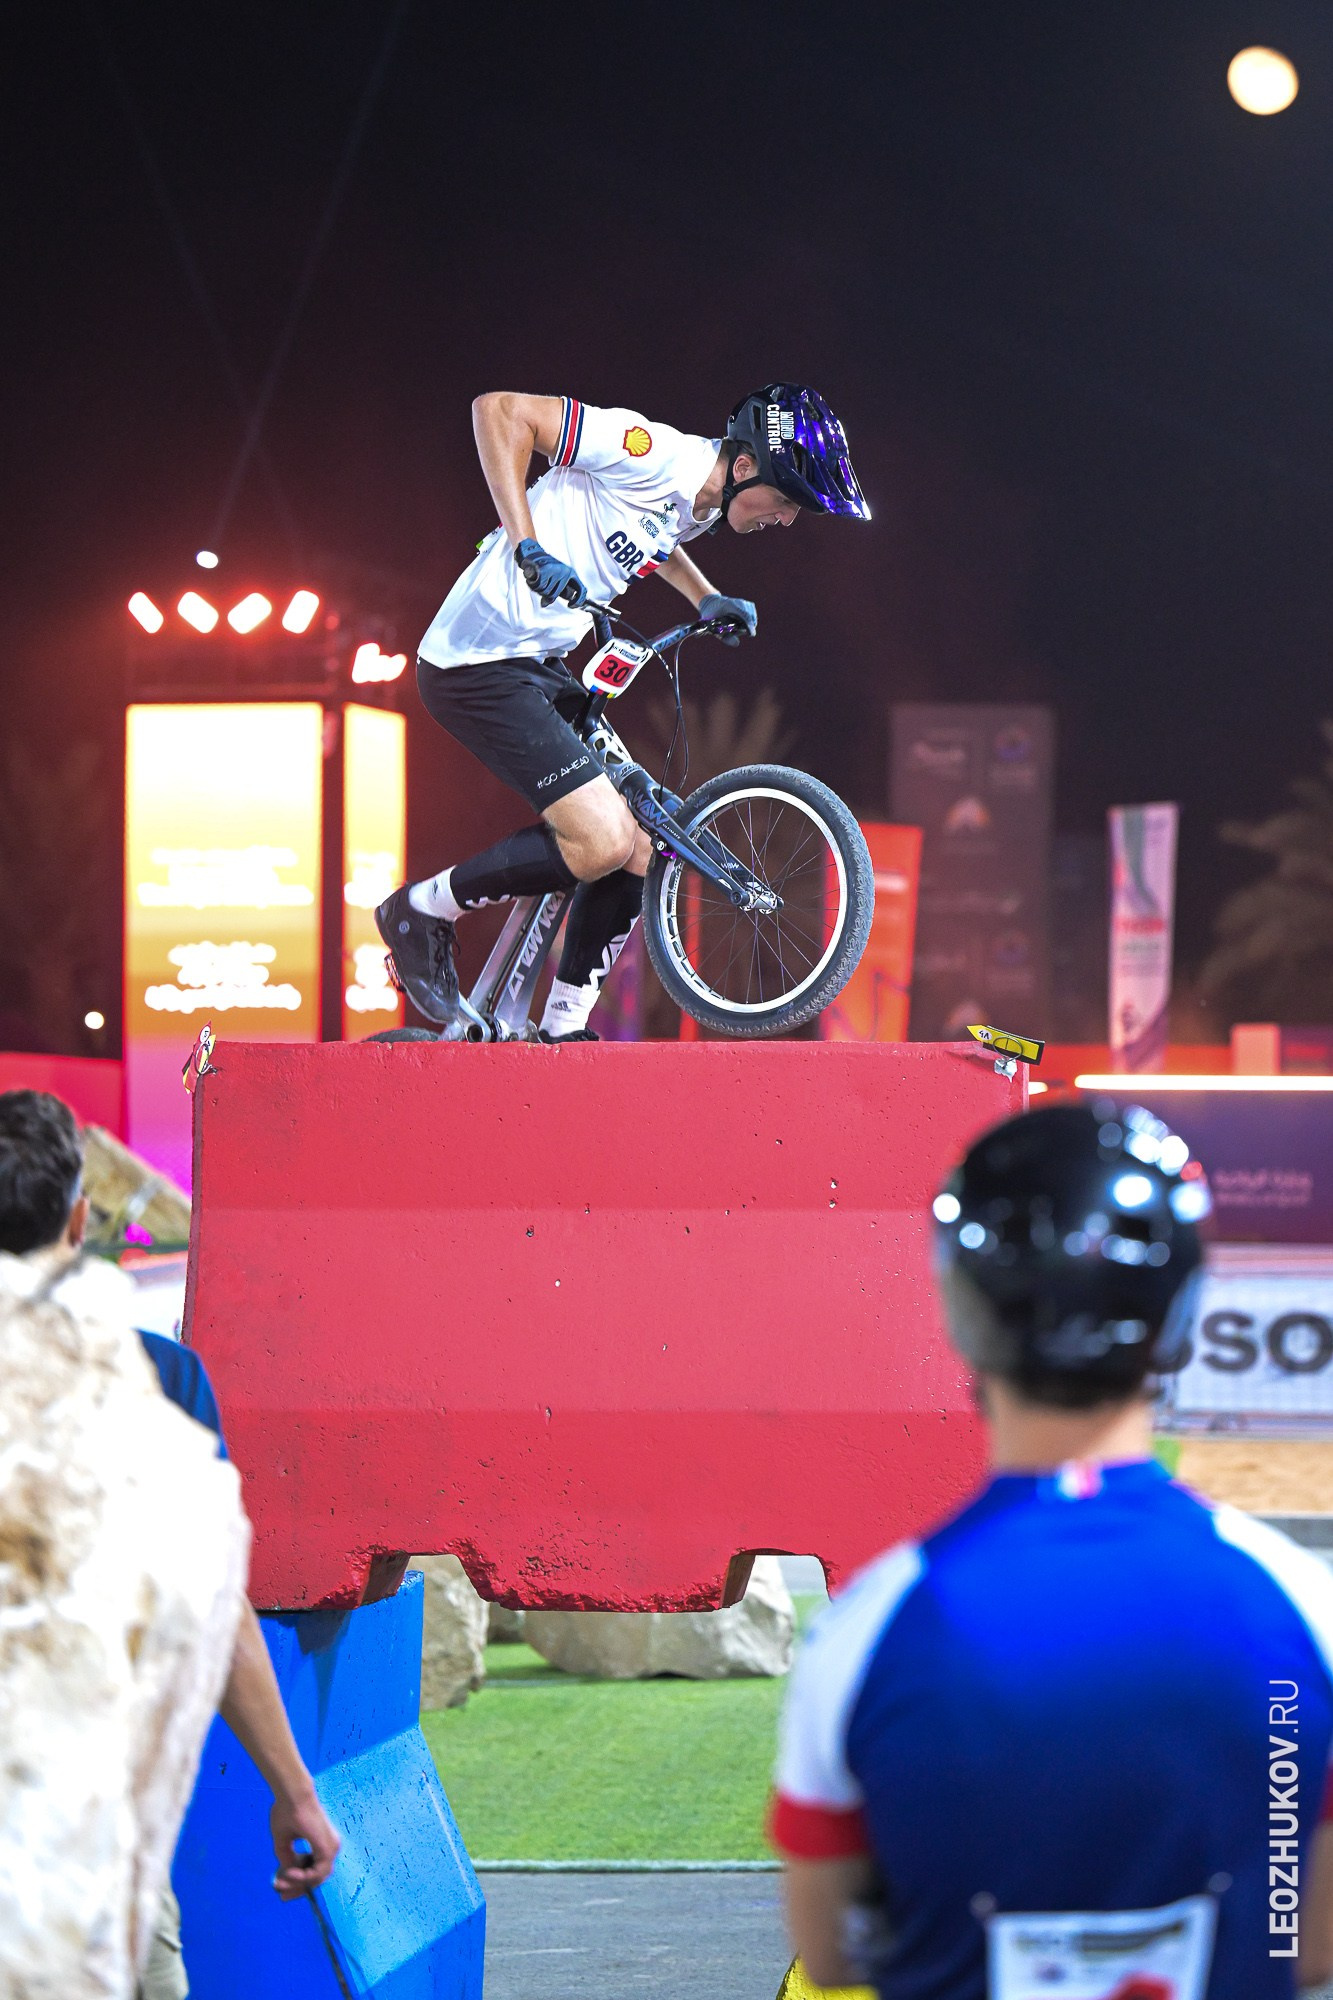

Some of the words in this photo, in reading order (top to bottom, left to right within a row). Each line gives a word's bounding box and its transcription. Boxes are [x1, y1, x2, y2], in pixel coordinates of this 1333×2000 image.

[766, 404, 783, 452] CONTROL
[605, 530, 645, 572] GBR
[600, 659, 630, 683] 30
[560, 755, 590, 777] AHEAD
